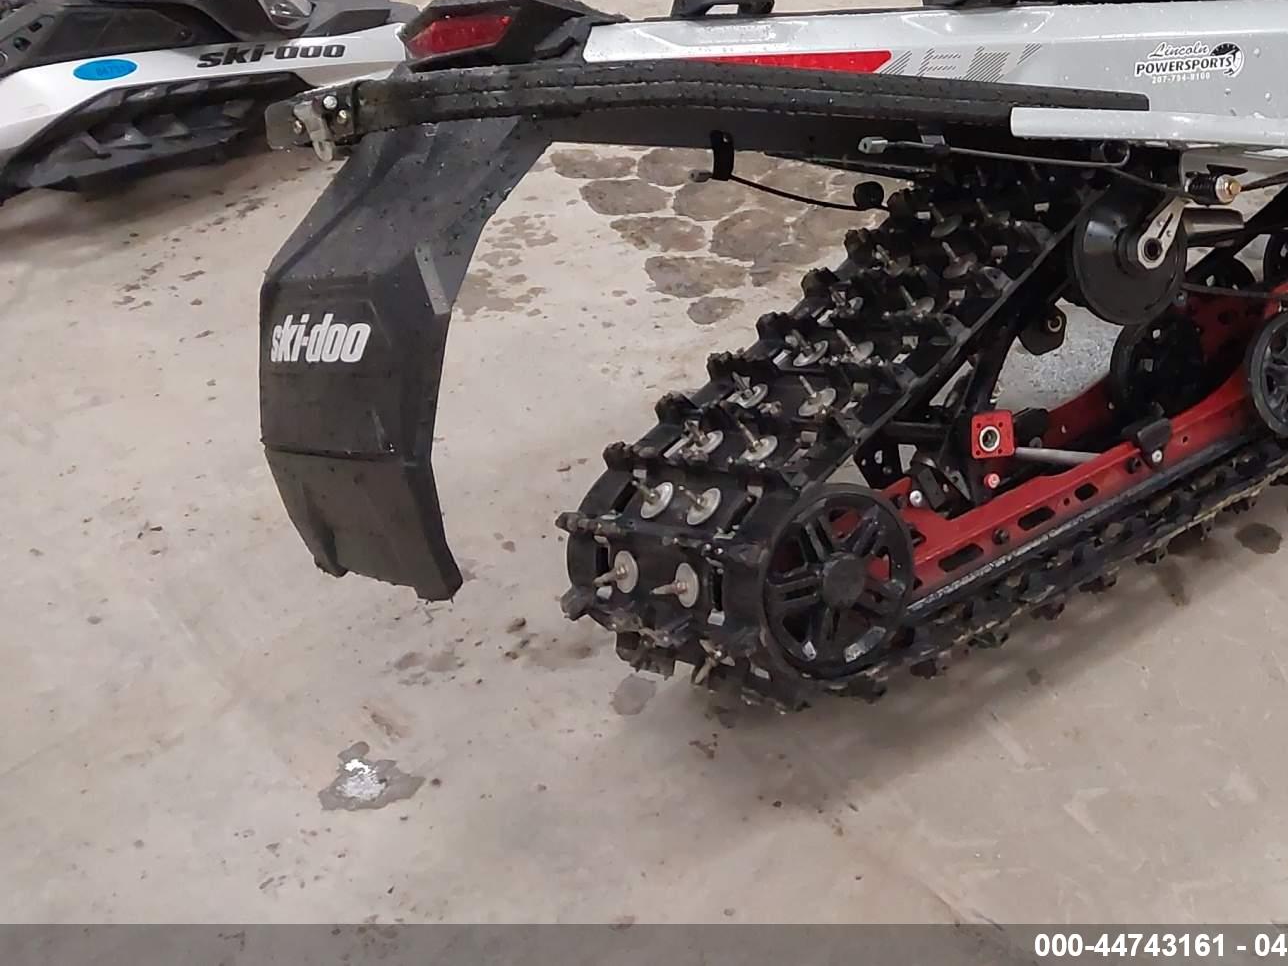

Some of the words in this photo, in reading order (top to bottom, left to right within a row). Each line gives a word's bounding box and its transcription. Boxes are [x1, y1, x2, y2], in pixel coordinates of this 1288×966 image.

[1149, 41, 1209, 58] Lincoln
[1136, 56, 1233, 75] POWERSPORTS
[271, 313, 371, 363] ski-doo
